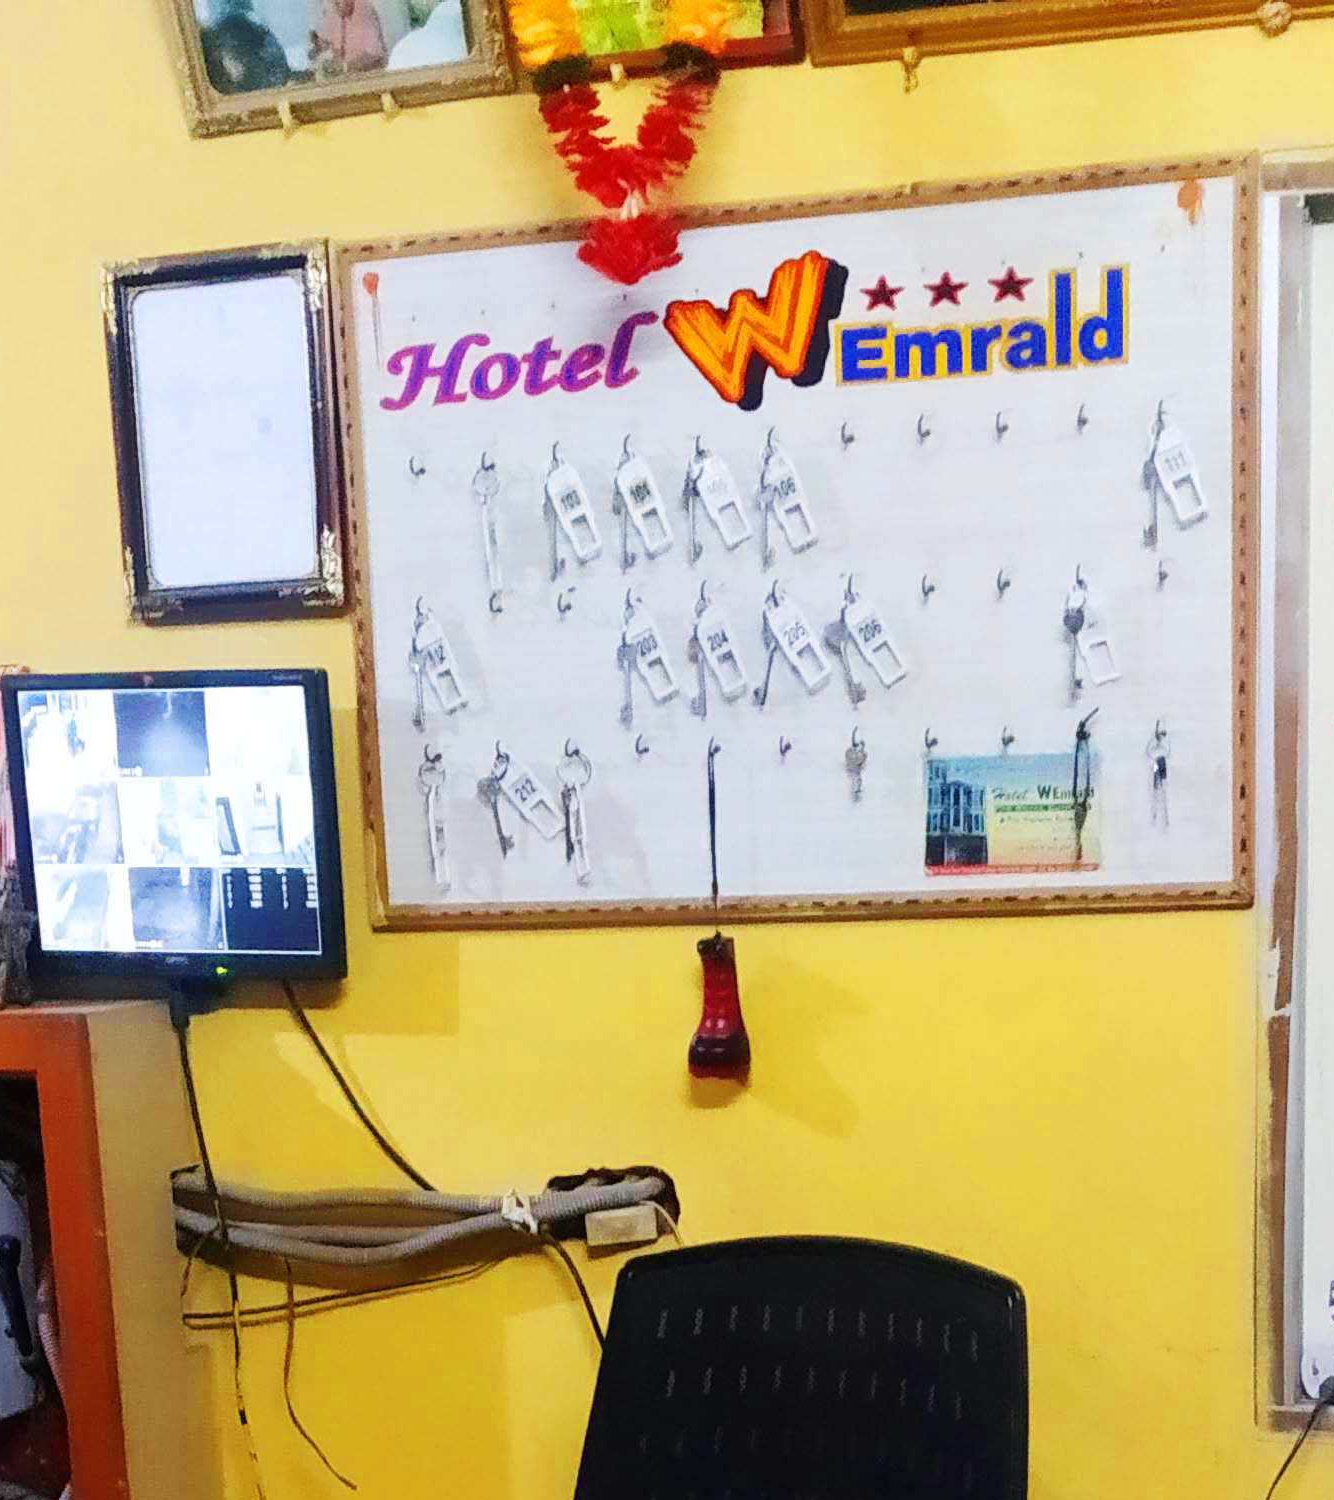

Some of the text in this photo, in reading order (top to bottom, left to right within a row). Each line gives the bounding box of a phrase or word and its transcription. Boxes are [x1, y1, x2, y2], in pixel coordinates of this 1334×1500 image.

[379, 250, 1132, 411] Hotel W Emrald
[514, 777, 538, 802] 212
